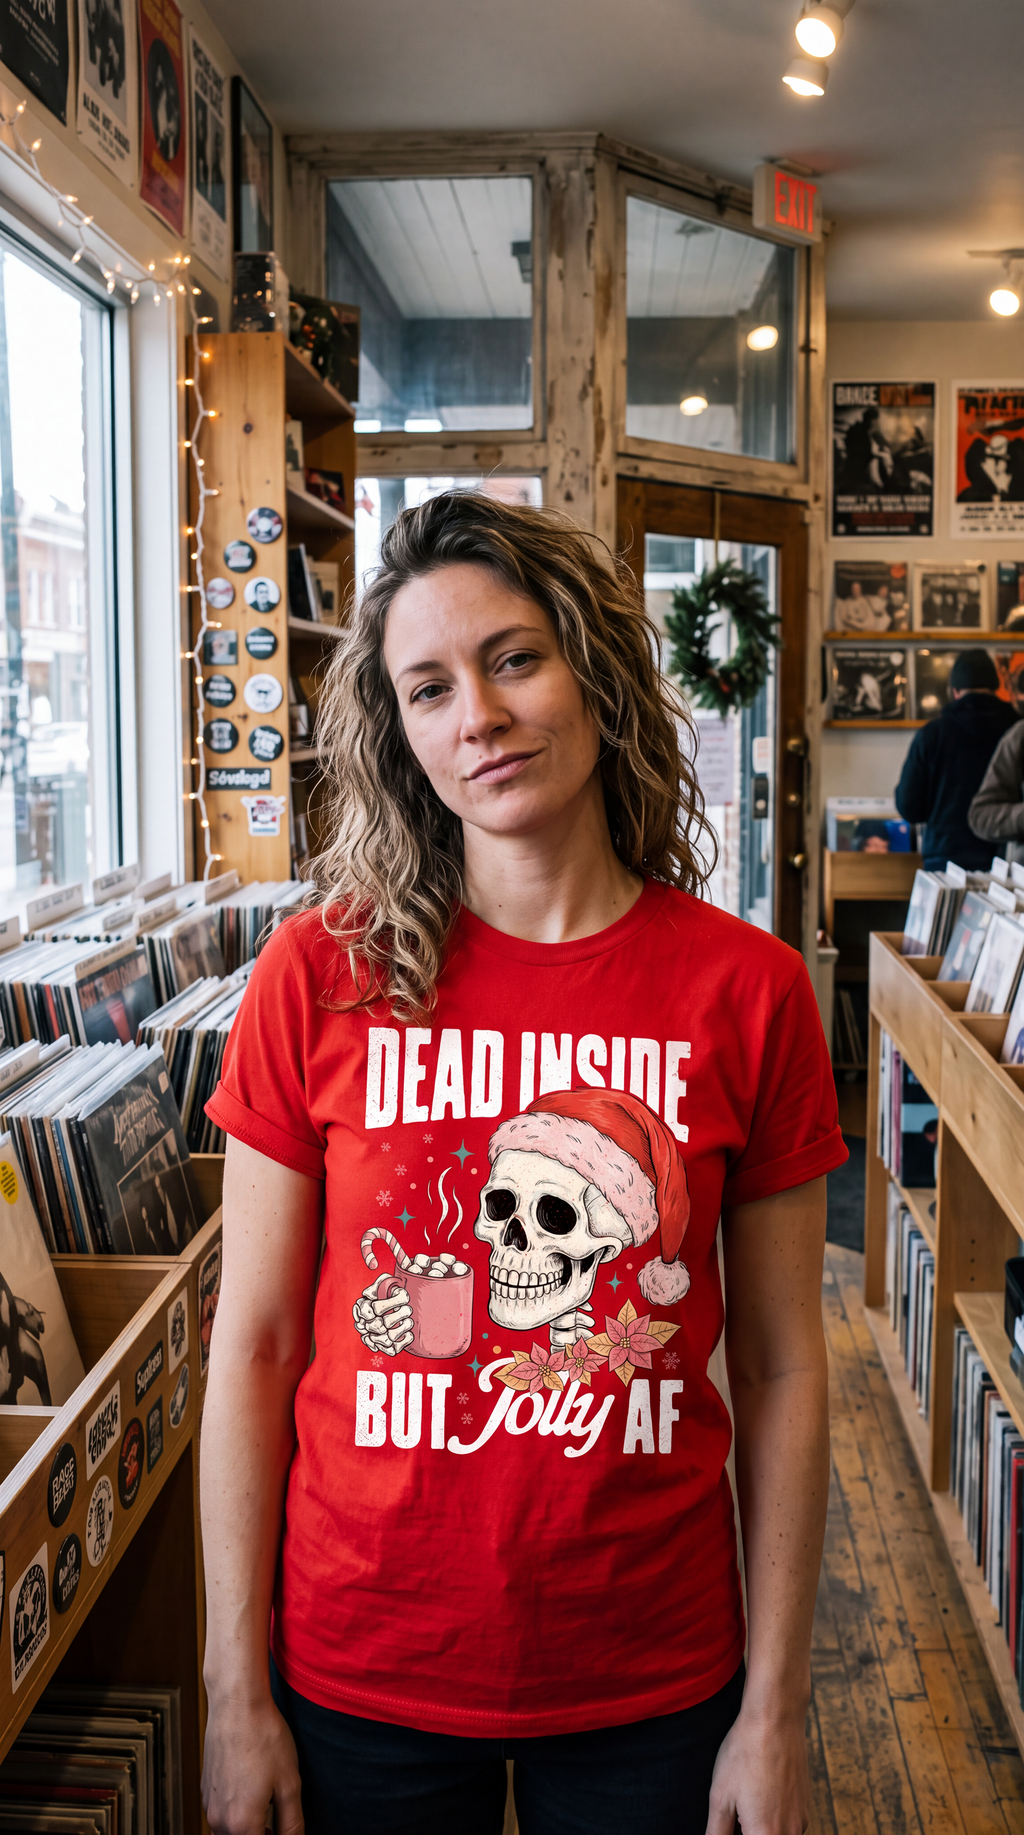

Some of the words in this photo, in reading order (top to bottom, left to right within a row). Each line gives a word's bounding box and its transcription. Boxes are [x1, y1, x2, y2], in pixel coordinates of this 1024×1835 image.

[775, 171, 817, 234] EXIT
[365, 1027, 504, 1129] DEAD
[519, 1031, 692, 1144] INSIDE
[355, 1371, 453, 1449] BUT
[447, 1357, 615, 1458] Jolly
[622, 1379, 684, 1454] AF
